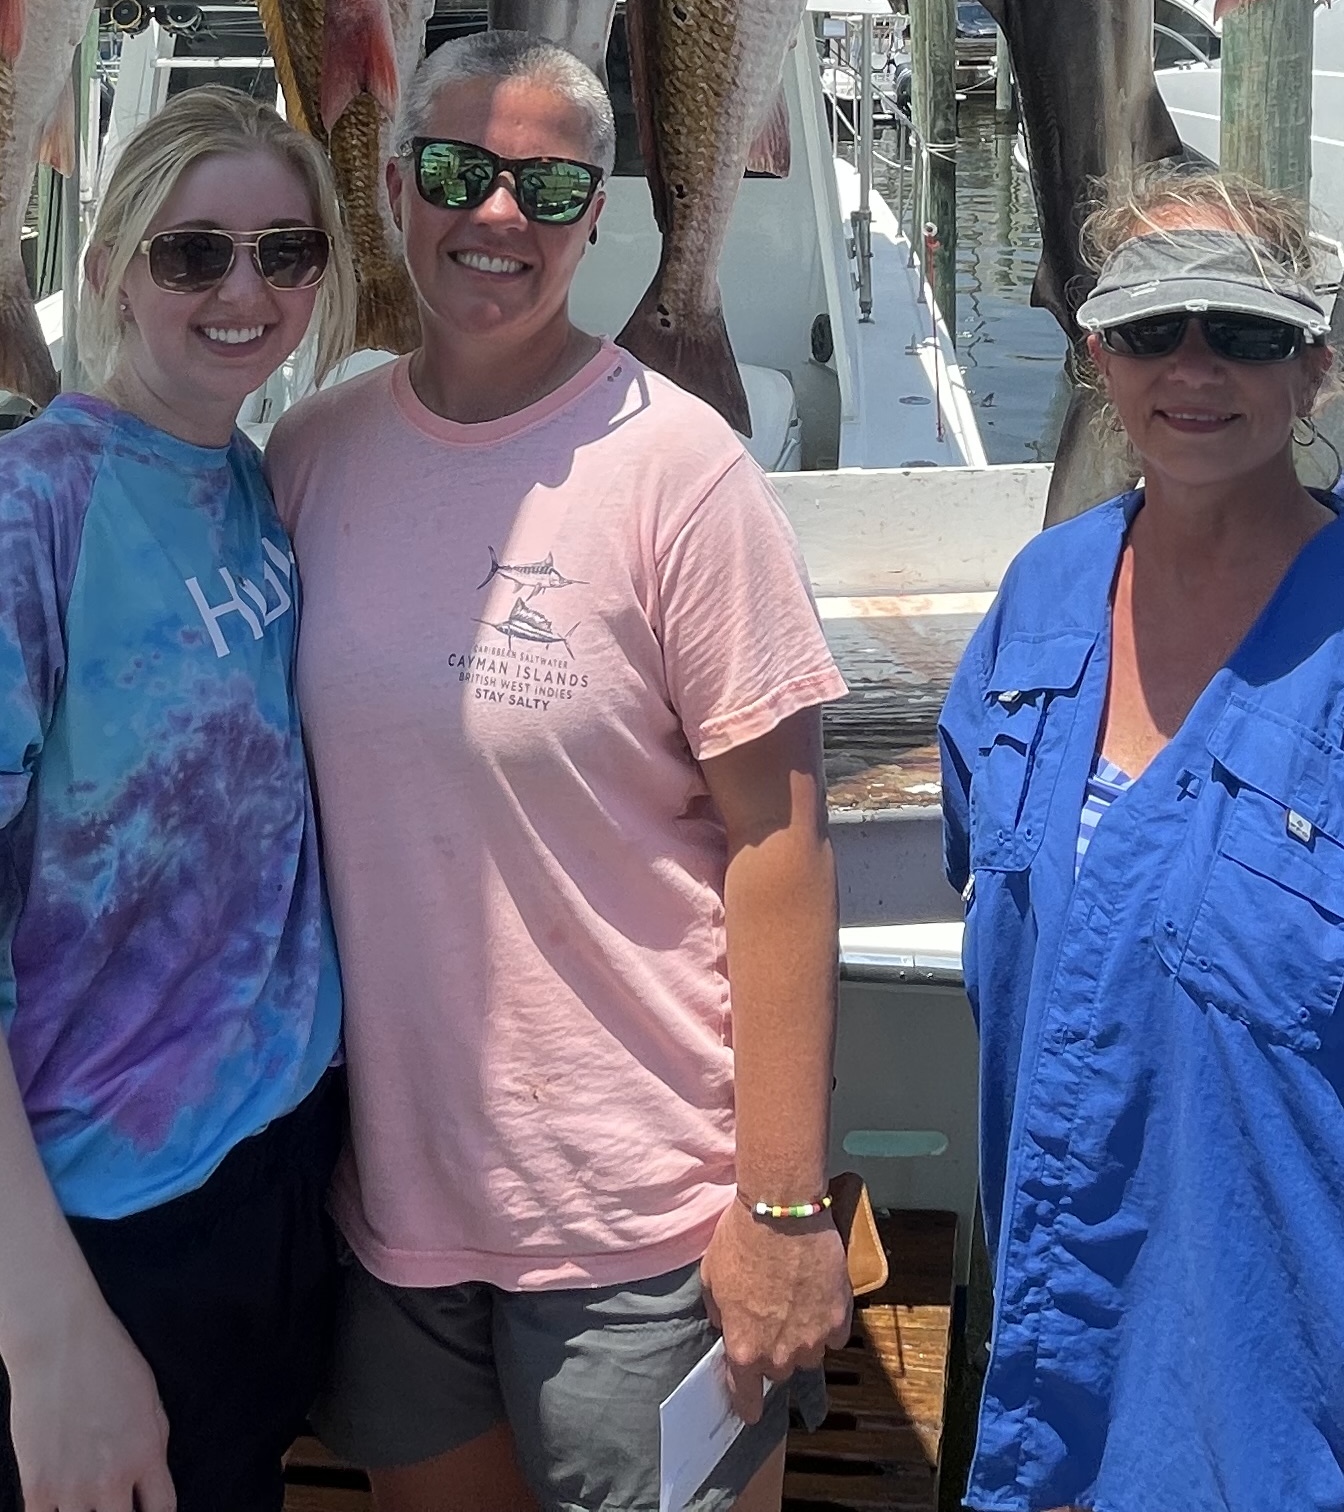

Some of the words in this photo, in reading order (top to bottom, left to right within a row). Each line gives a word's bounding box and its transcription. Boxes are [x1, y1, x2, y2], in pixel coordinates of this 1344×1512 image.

[448, 653, 508, 676] CAYMAN
[516, 665, 589, 688] ISLANDS
[459, 671, 496, 688] BRITISH
[501, 679, 531, 694] WEST
[535, 686, 573, 700] INDIES
[475, 688, 505, 703] STAY
[508, 694, 551, 712] SALTY
